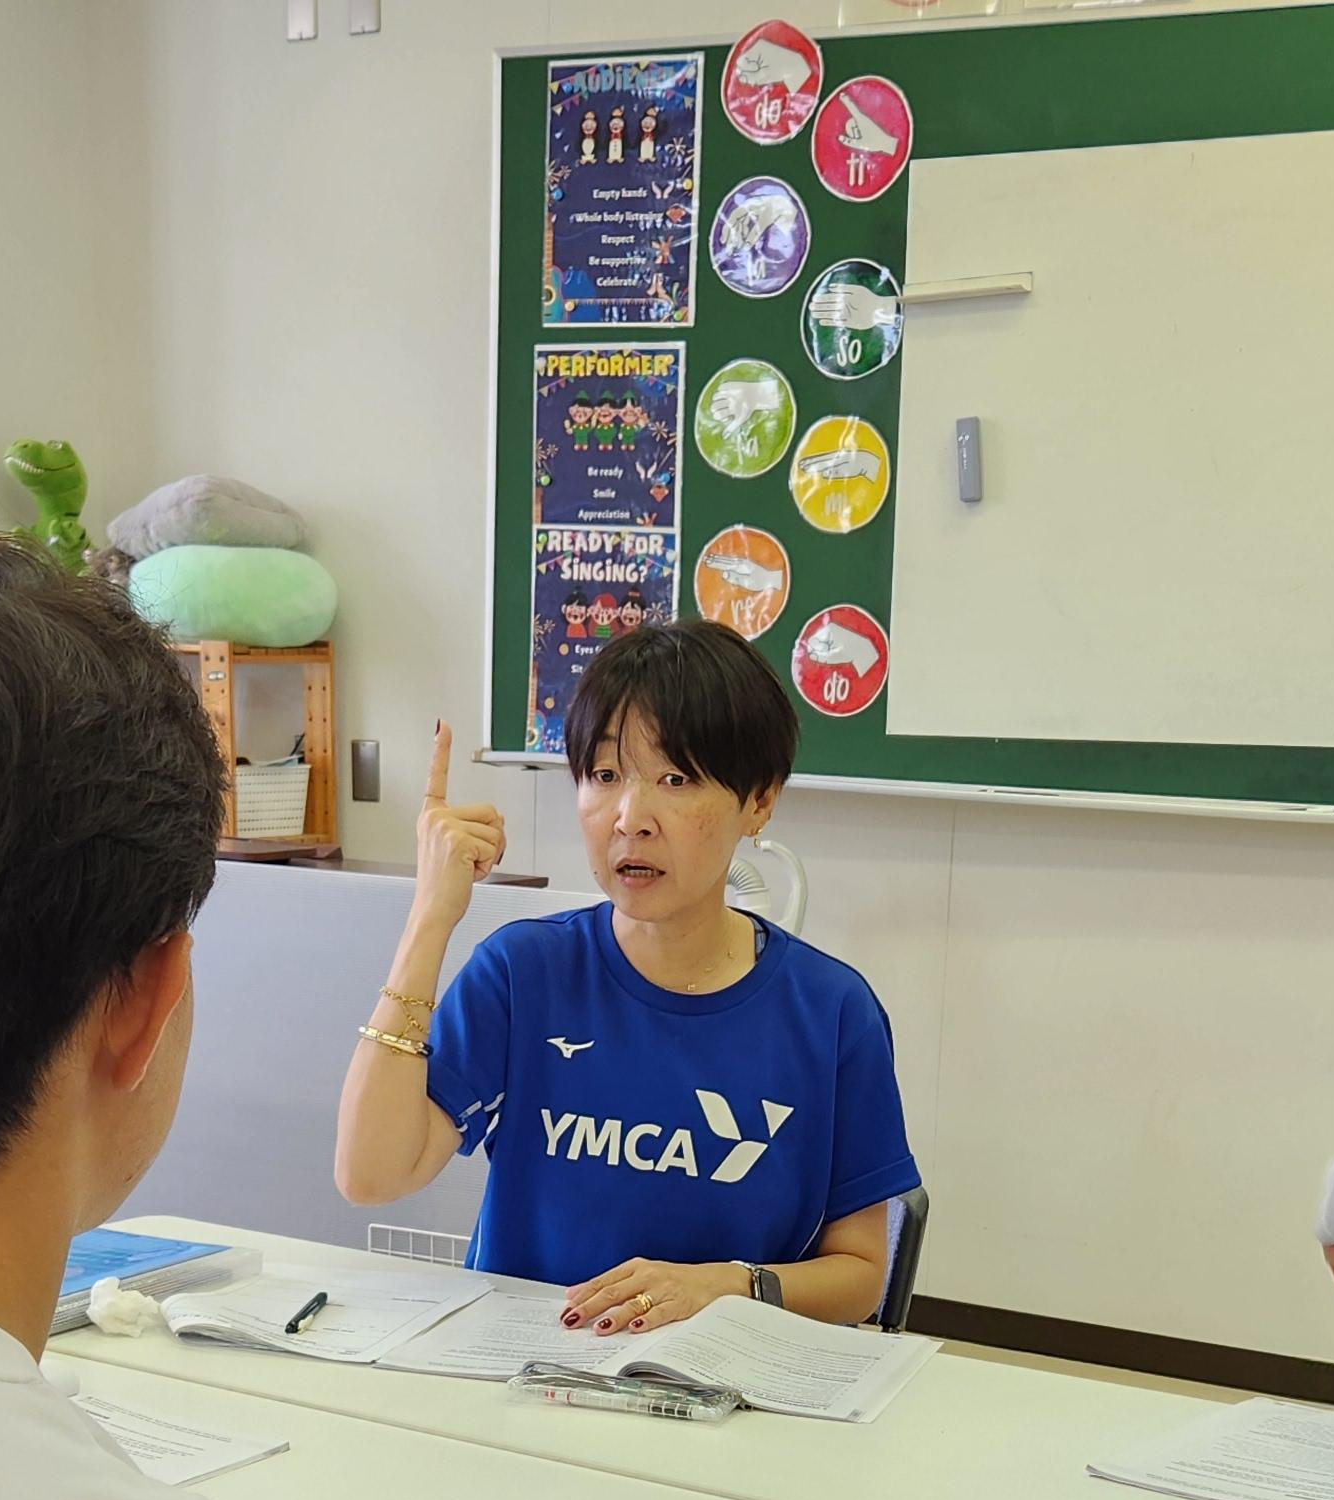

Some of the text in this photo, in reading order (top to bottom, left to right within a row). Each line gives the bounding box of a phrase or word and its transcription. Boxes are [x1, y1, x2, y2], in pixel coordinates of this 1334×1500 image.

[754, 92, 782, 130] do
[846, 152, 865, 187] ti
[593, 187, 647, 200] Empty hands
[576, 211, 663, 223] Whole body listening
[601, 235, 635, 246] Respect
[588, 256, 646, 267] Be supportive
[596, 276, 637, 287] Celebrate
[836, 335, 862, 368] so
[546, 354, 670, 377] PERFORMER
[587, 466, 623, 479] Be ready
[593, 488, 616, 499] Smile
[578, 509, 630, 522] Appreciation
[547, 530, 664, 555] READY FOR
[575, 644, 594, 656] Eyes
[823, 671, 850, 705] do
[540, 1108, 699, 1178] YMCA
